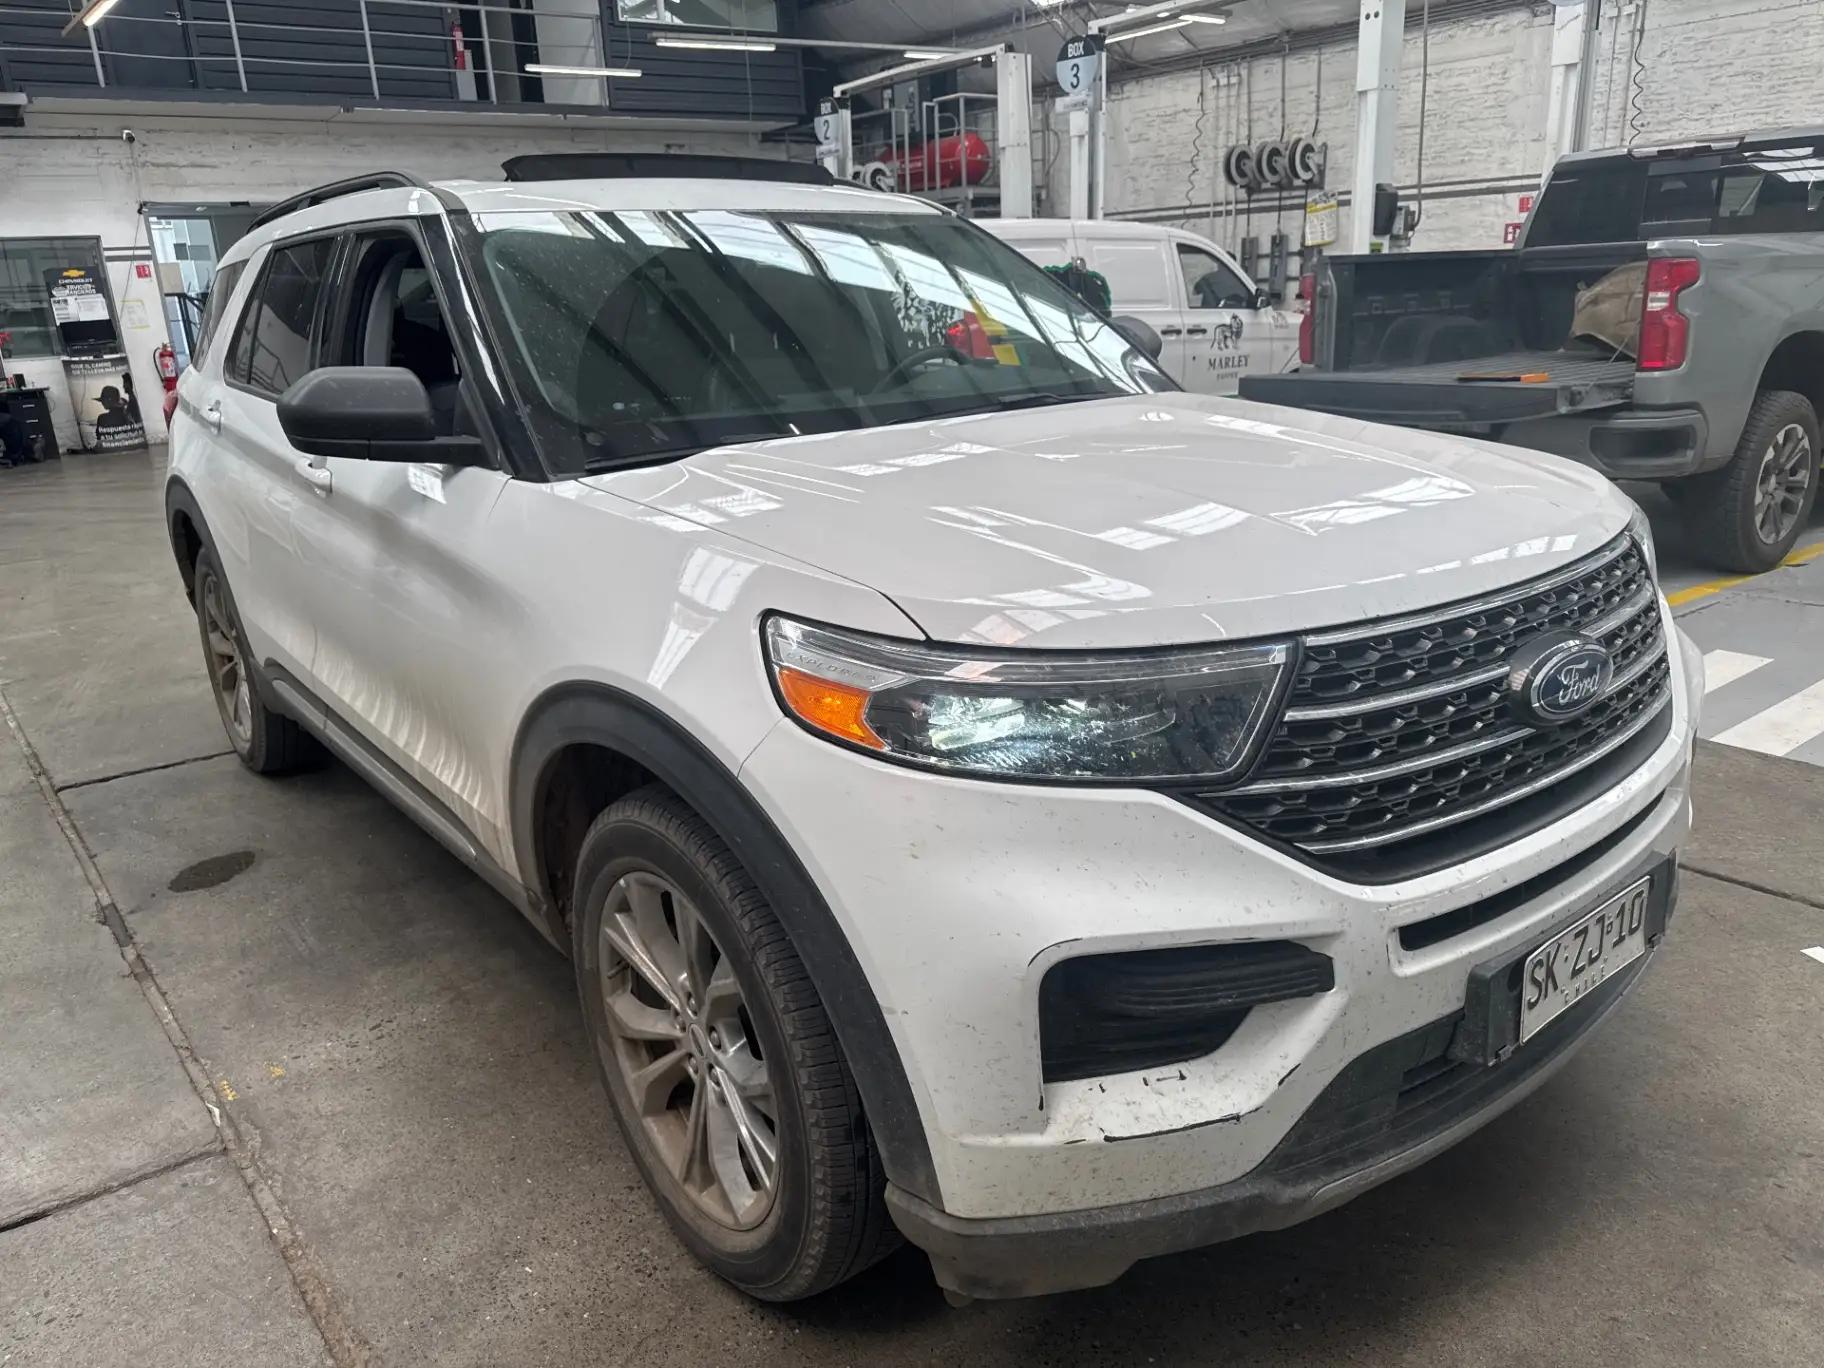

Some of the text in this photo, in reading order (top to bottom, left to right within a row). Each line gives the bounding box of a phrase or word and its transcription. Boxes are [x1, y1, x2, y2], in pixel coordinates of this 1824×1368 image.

[1067, 41, 1084, 58] BOX
[1070, 63, 1080, 89] 3
[820, 102, 832, 115] BOX
[823, 120, 830, 140] 2
[1208, 354, 1250, 371] MARLEY
[1556, 659, 1600, 706] Ford
